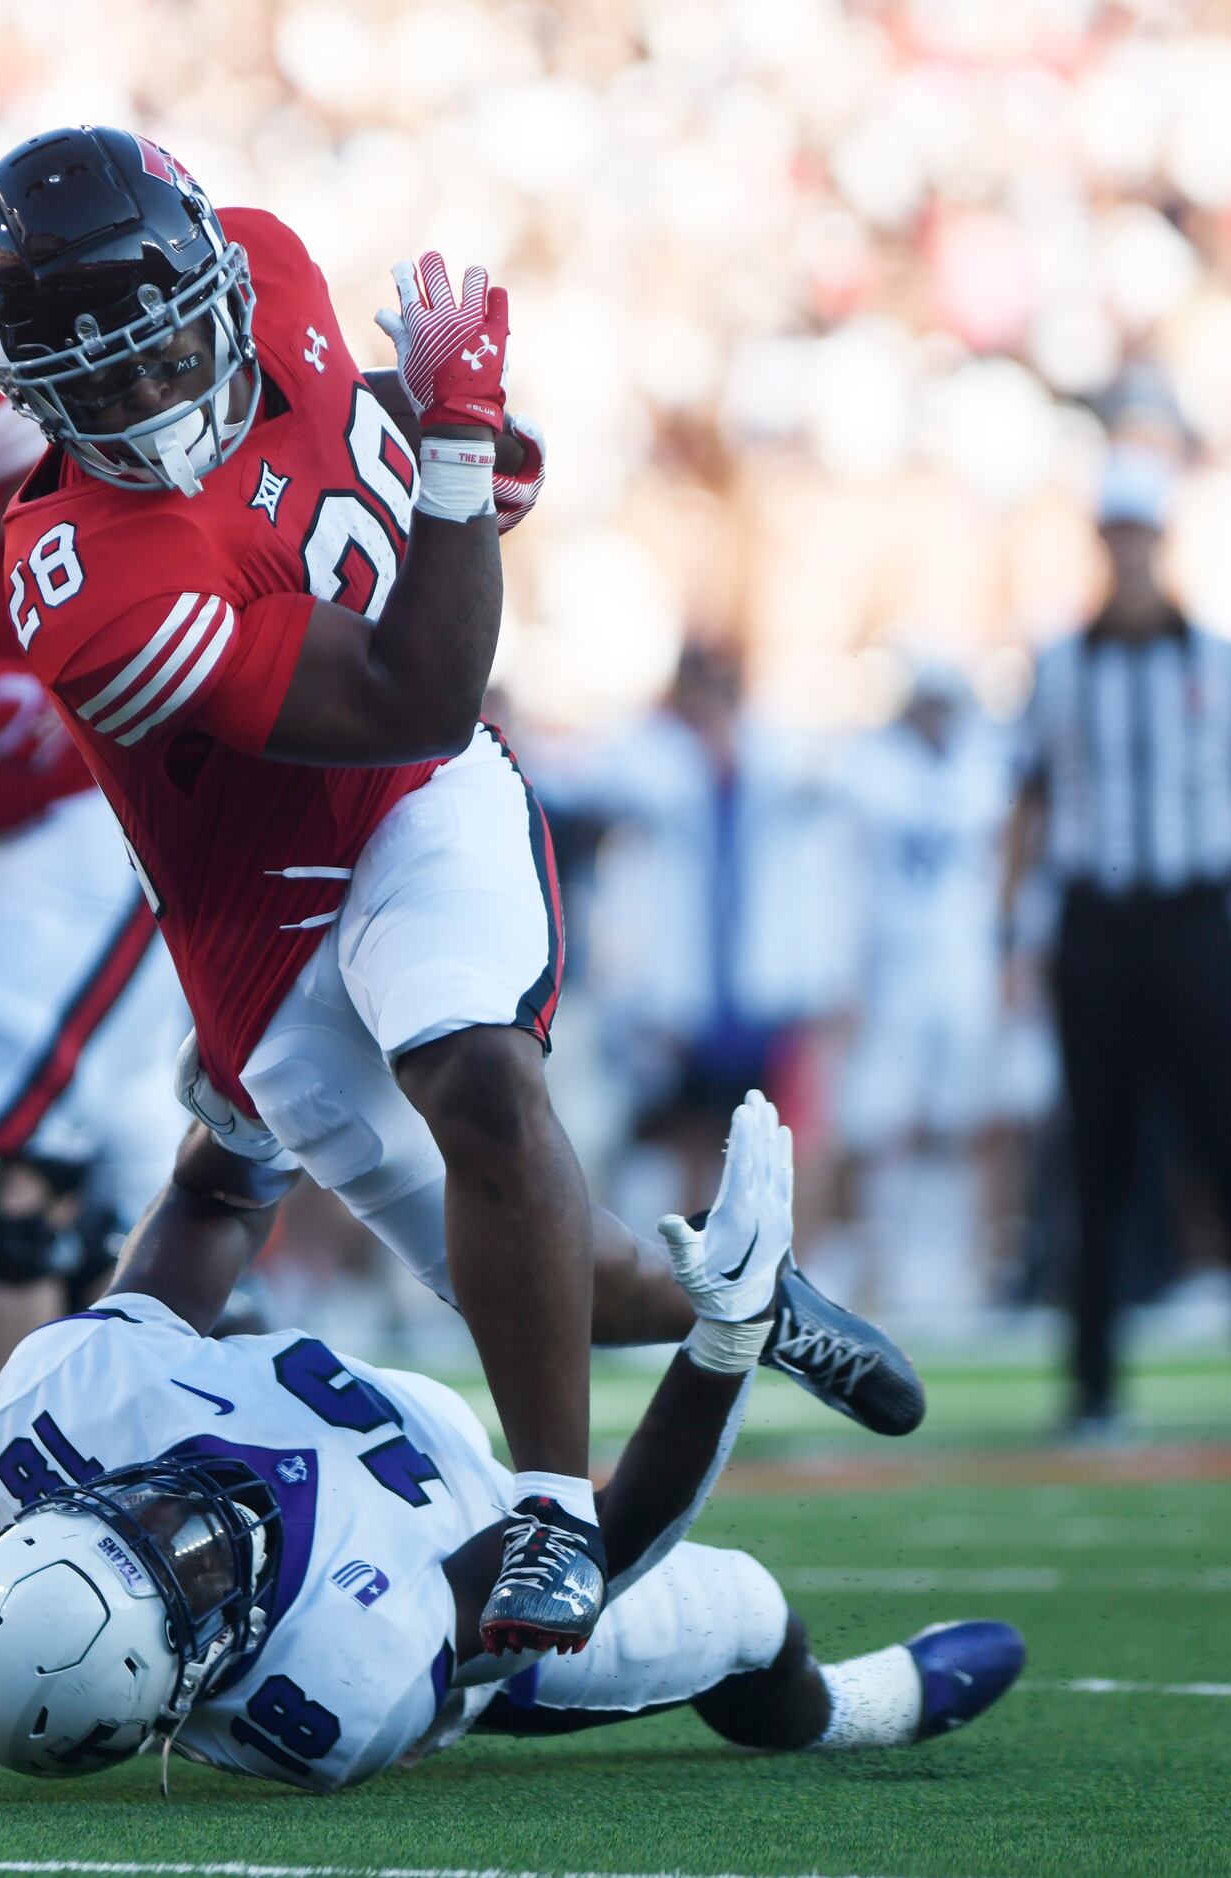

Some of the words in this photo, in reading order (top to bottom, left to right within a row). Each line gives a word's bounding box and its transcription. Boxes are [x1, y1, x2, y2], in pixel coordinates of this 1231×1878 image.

[176, 355, 199, 373] ME
[459, 452, 477, 463] THE
[9, 521, 86, 656] 28
[97, 1536, 144, 1588] TEXANS
[230, 1673, 341, 1777] 18
